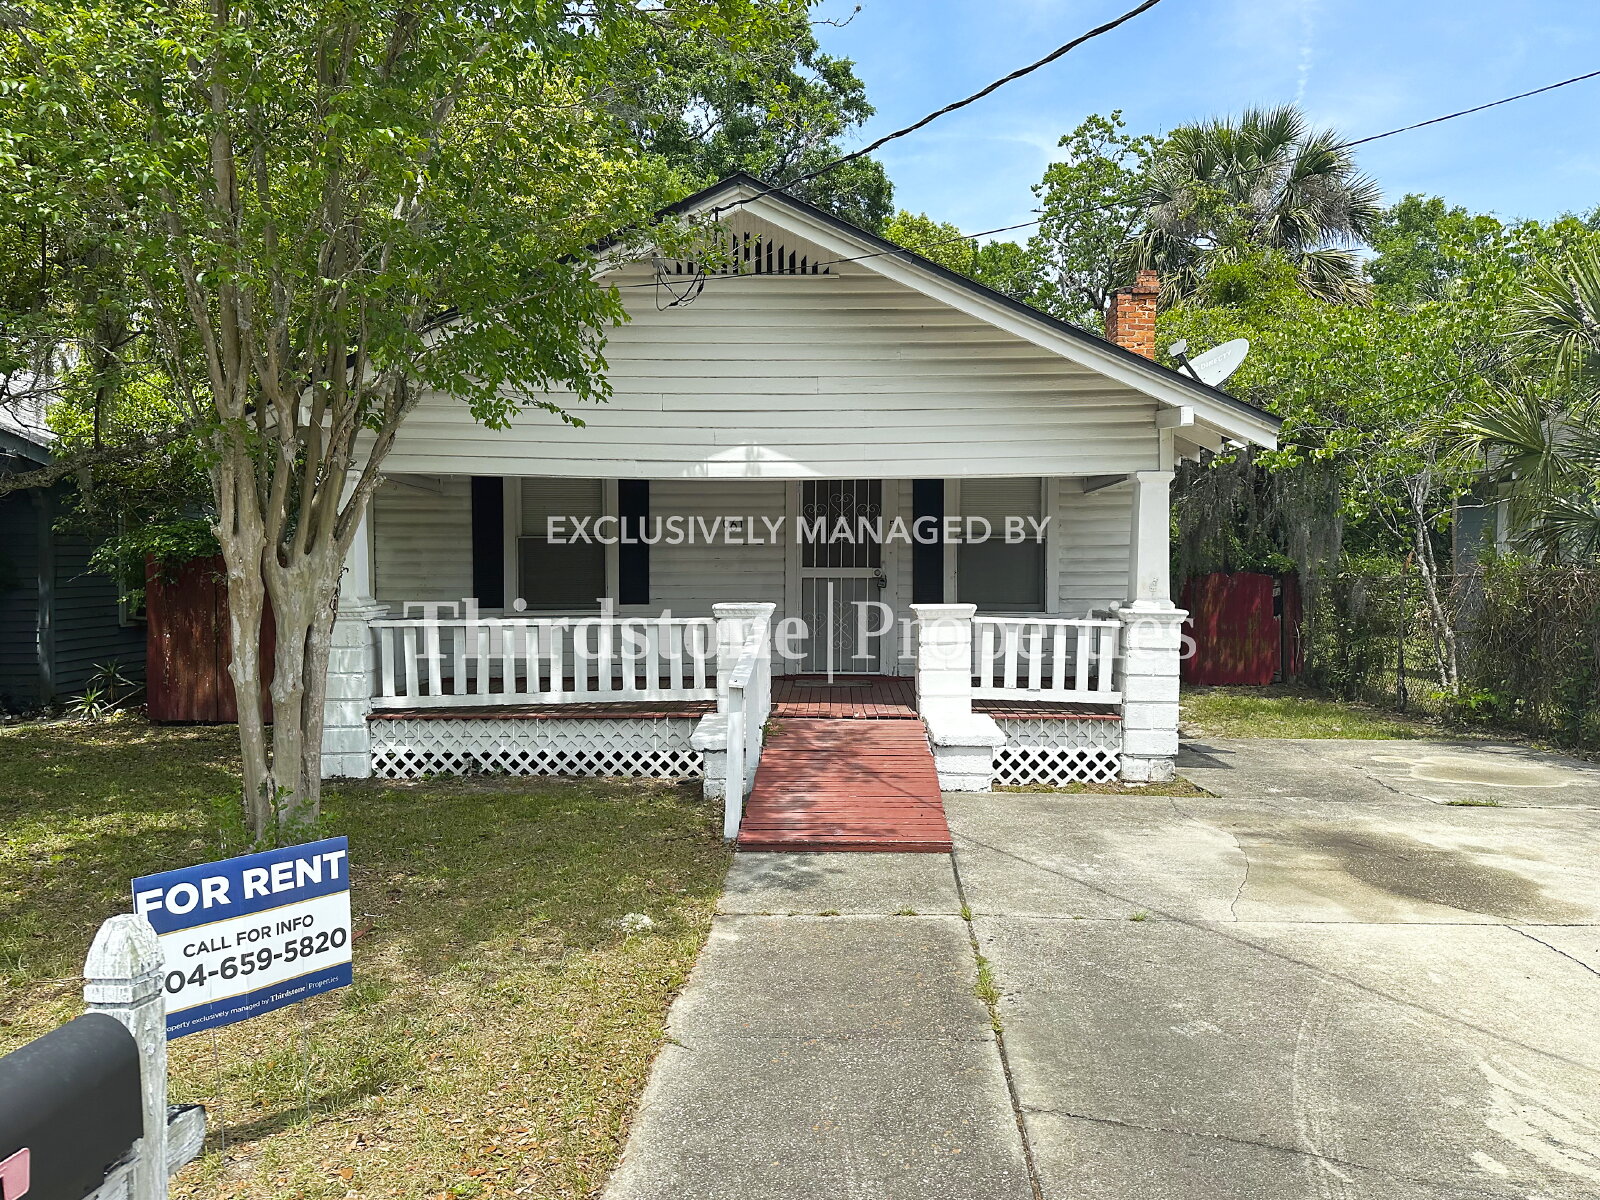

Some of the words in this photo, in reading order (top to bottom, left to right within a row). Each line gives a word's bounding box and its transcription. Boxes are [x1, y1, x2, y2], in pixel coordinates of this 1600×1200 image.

[136, 876, 232, 922] FOR
[242, 850, 346, 899] RENT
[165, 927, 347, 994] 04-659-5820
[183, 936, 232, 958] CALL
[236, 925, 272, 946] FOR
[276, 914, 314, 936] INFO
[166, 1020, 191, 1032] operty
[191, 1010, 230, 1025] exclusively
[230, 1001, 261, 1013] managed
[270, 986, 306, 1002] Thirdstone
